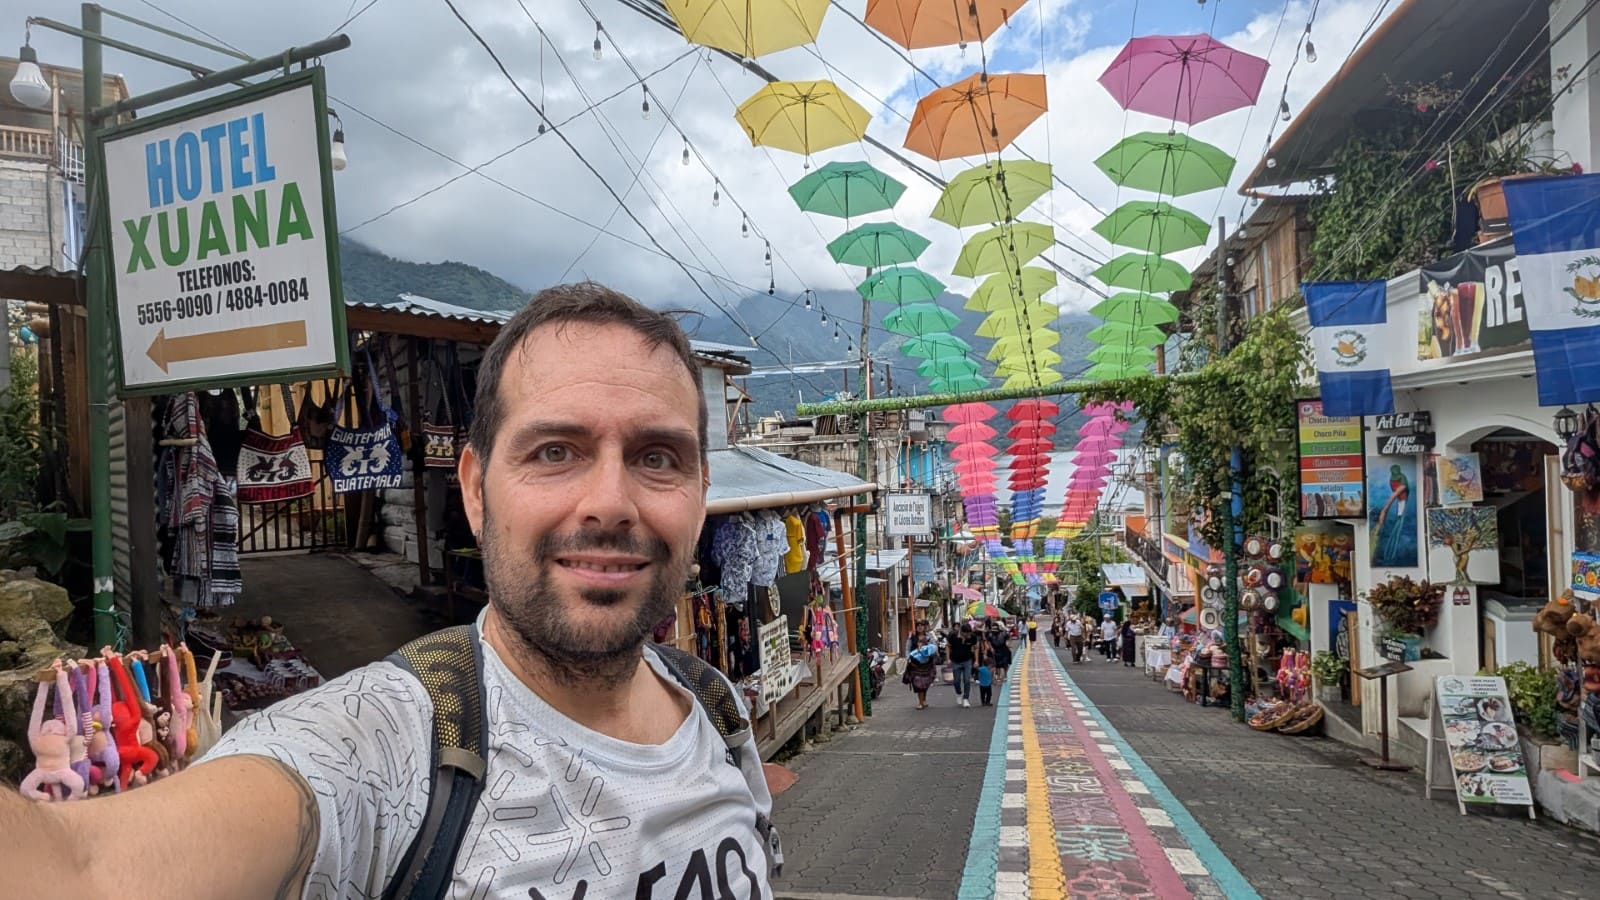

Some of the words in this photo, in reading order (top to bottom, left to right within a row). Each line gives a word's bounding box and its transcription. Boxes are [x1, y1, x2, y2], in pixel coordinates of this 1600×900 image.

[145, 112, 276, 209] HOTEL
[122, 182, 314, 275] XUANA
[177, 259, 256, 293] TELEFONOS:
[137, 292, 213, 326] 5556-9090
[216, 292, 222, 314] /
[225, 277, 309, 312] 4884-0084
[330, 422, 392, 444] GUATEMALA
[334, 474, 402, 493] GUATEMALA
